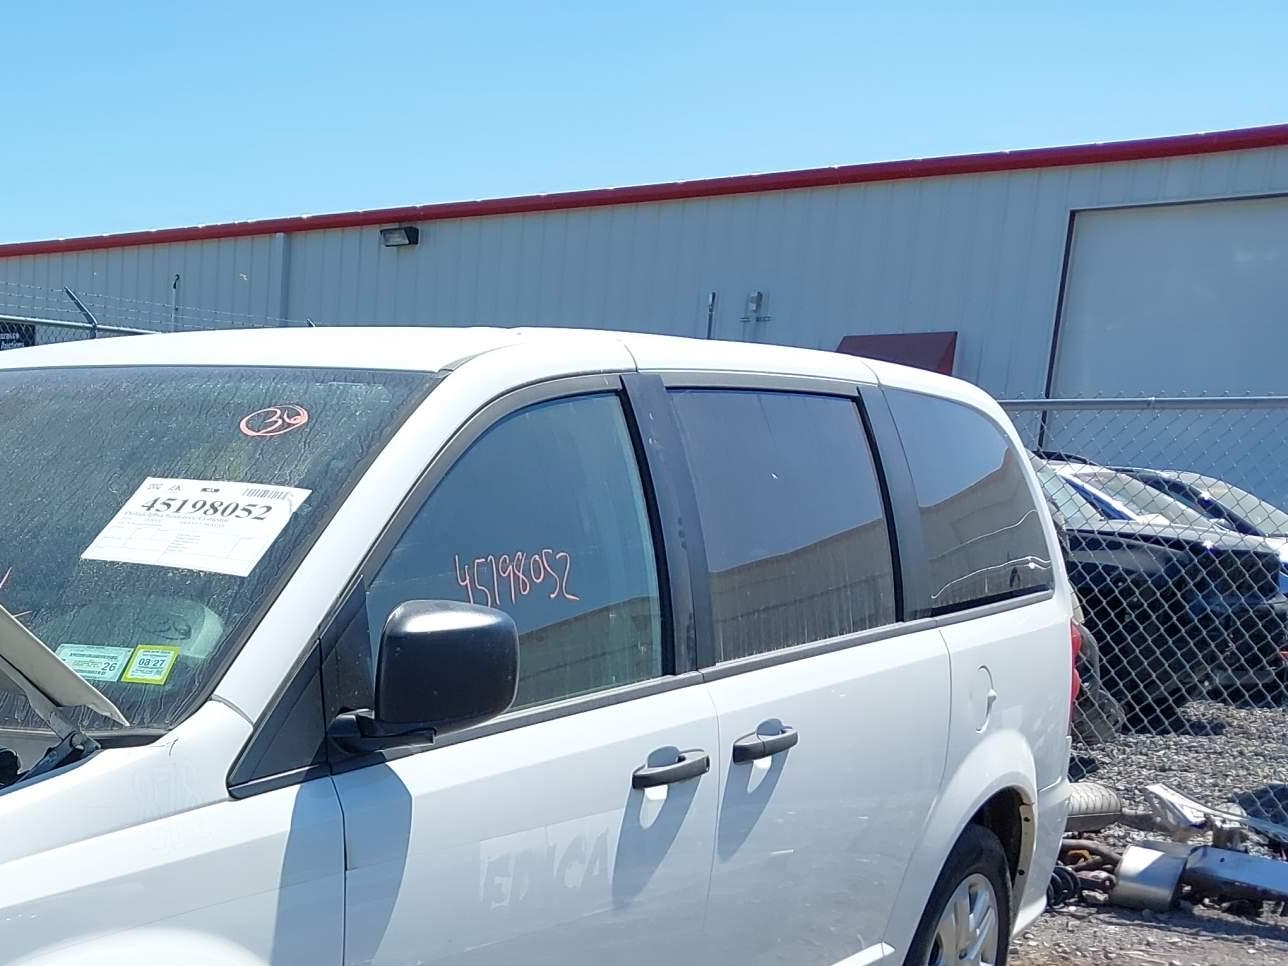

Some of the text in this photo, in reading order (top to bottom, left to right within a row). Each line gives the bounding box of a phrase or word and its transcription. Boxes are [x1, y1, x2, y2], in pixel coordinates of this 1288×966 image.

[140, 496, 272, 521] 45198052
[455, 549, 581, 609] 45198052
[101, 662, 118, 672] 26
[152, 658, 167, 667] 27
